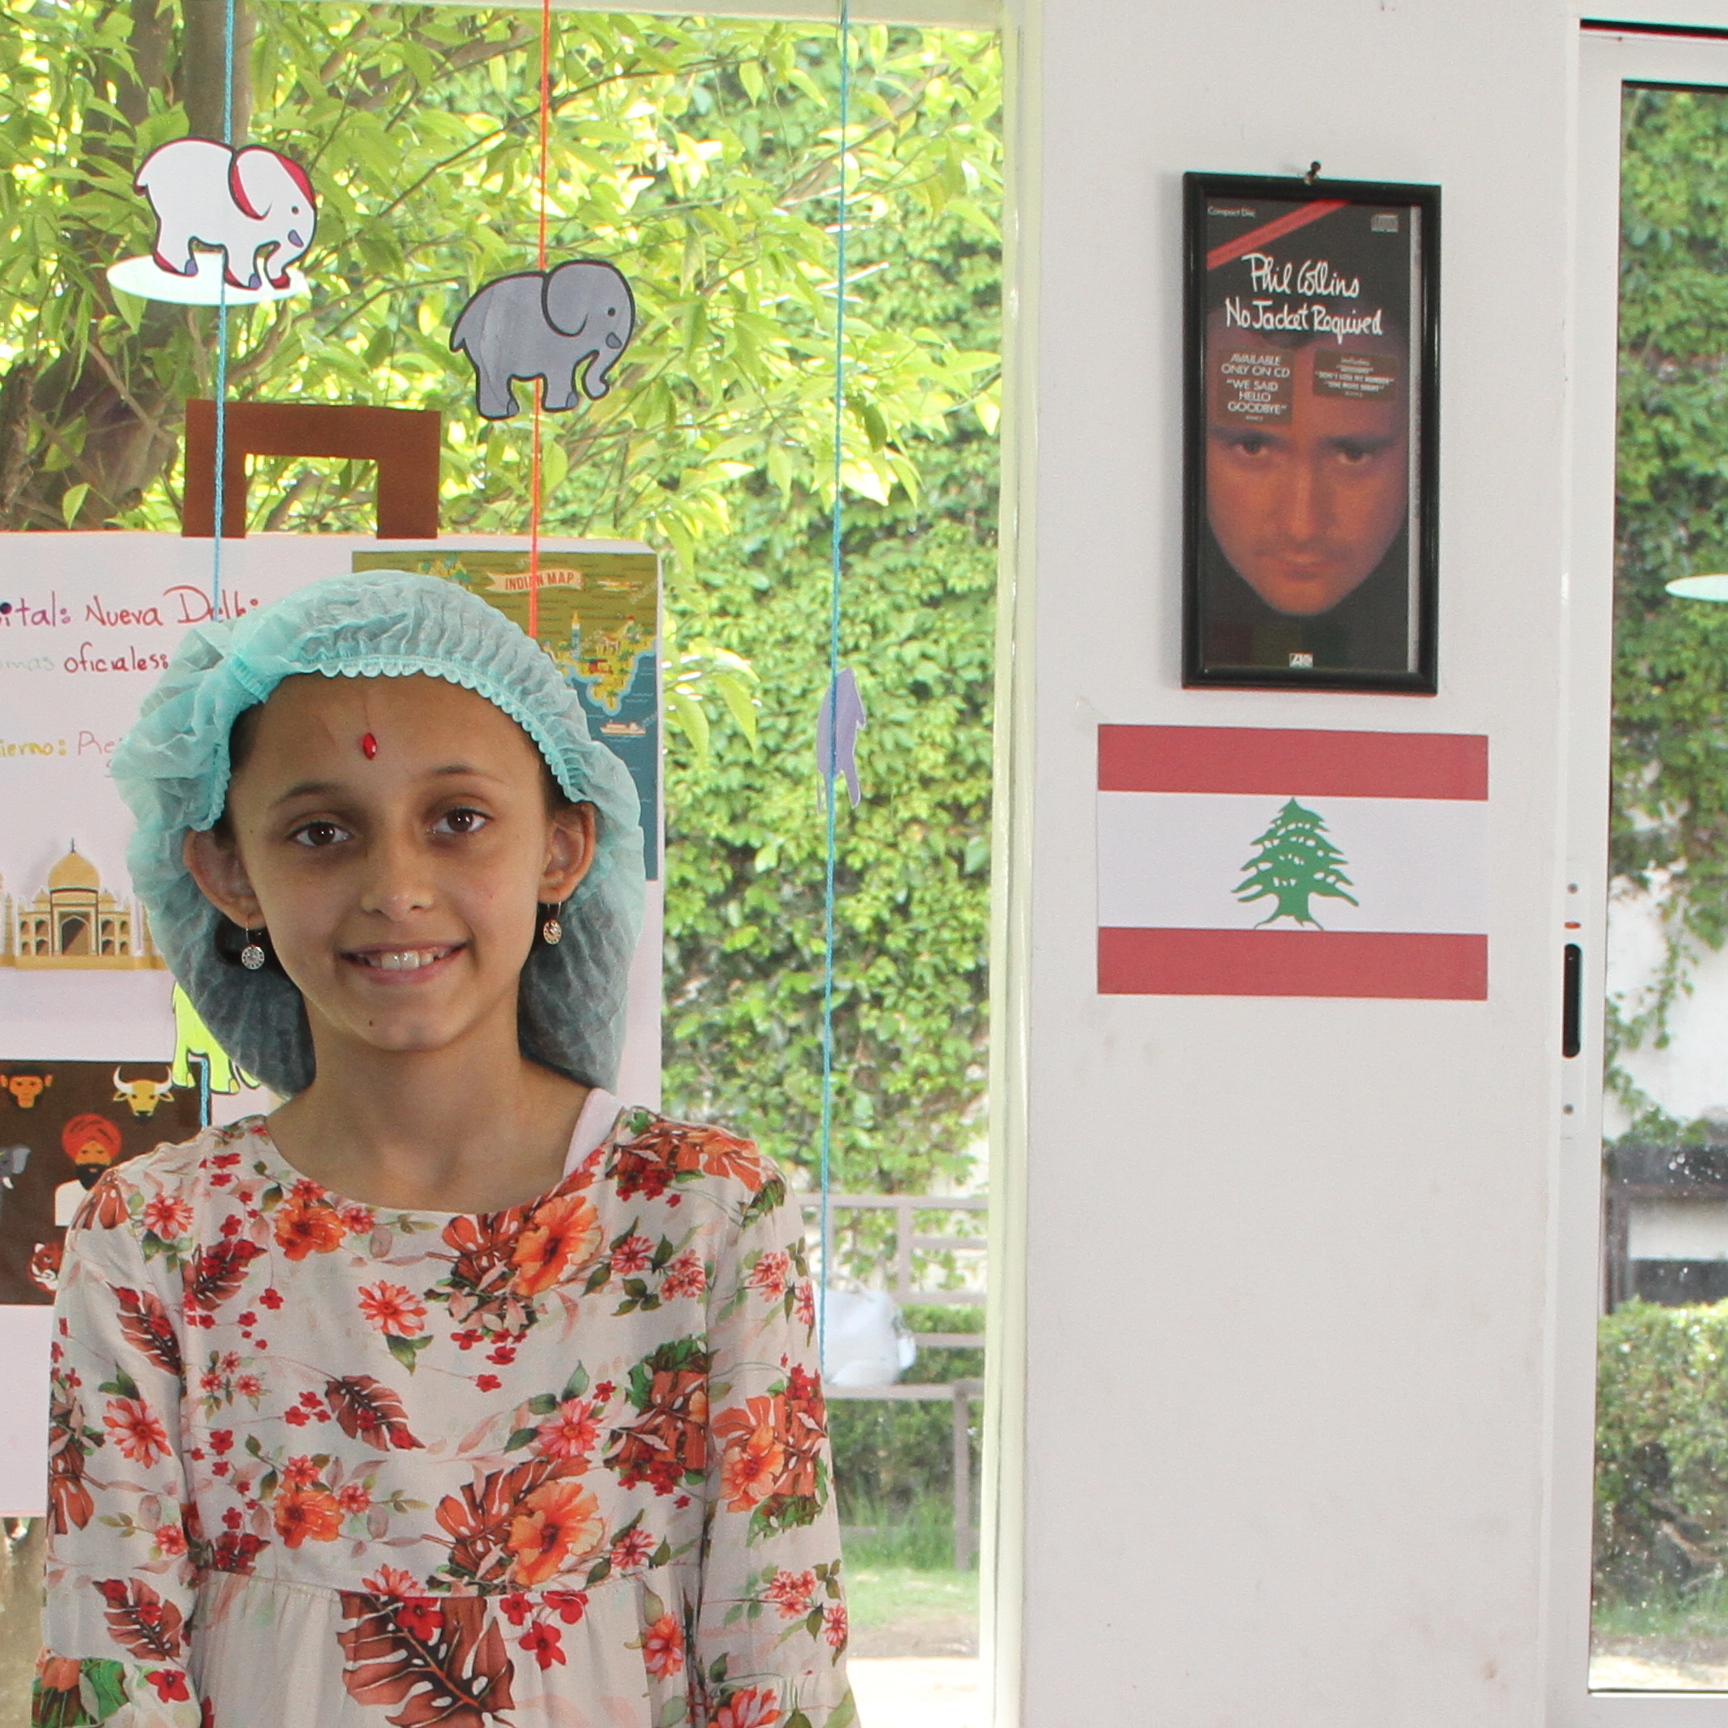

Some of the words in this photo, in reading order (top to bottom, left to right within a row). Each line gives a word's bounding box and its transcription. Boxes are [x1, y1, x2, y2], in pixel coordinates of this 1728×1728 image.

[1241, 252, 1293, 294] Phil
[1297, 259, 1360, 298] Collins
[1225, 296, 1251, 328] No
[1252, 299, 1310, 330] Jacket
[1311, 303, 1384, 344] Required
[1230, 353, 1282, 366] AVAILABLE
[1221, 363, 1250, 375] ONLY
[1252, 365, 1272, 376] ON
[1273, 367, 1291, 378] CD
[1253, 380, 1279, 392] SAID
[1239, 390, 1271, 402] HELLO
[505, 574, 544, 591] INDIN
[547, 571, 575, 585] MAP
[84, 595, 165, 627] Nueva
